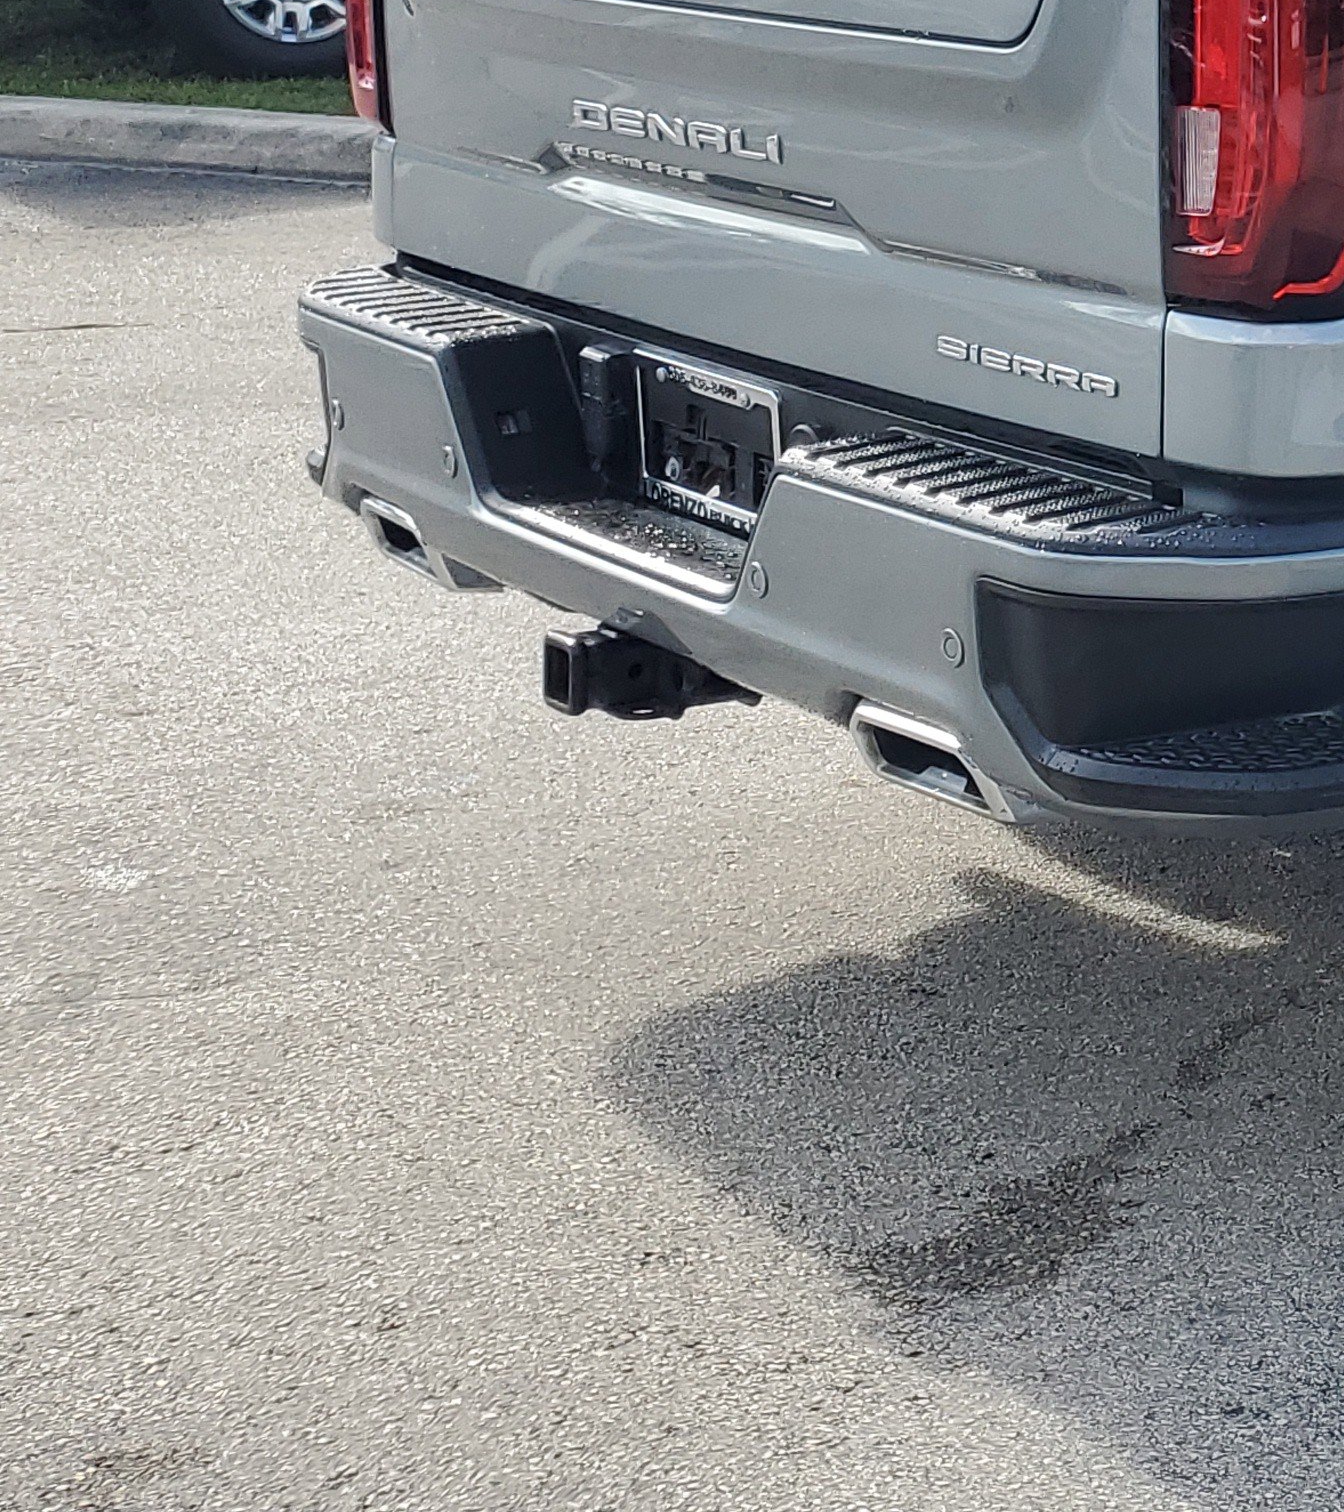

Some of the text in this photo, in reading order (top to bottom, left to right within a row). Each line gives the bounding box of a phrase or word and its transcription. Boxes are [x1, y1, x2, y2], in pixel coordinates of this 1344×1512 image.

[571, 98, 784, 165] DENALI
[937, 335, 1119, 397] SIERRA
[644, 479, 710, 522] LORENZO
